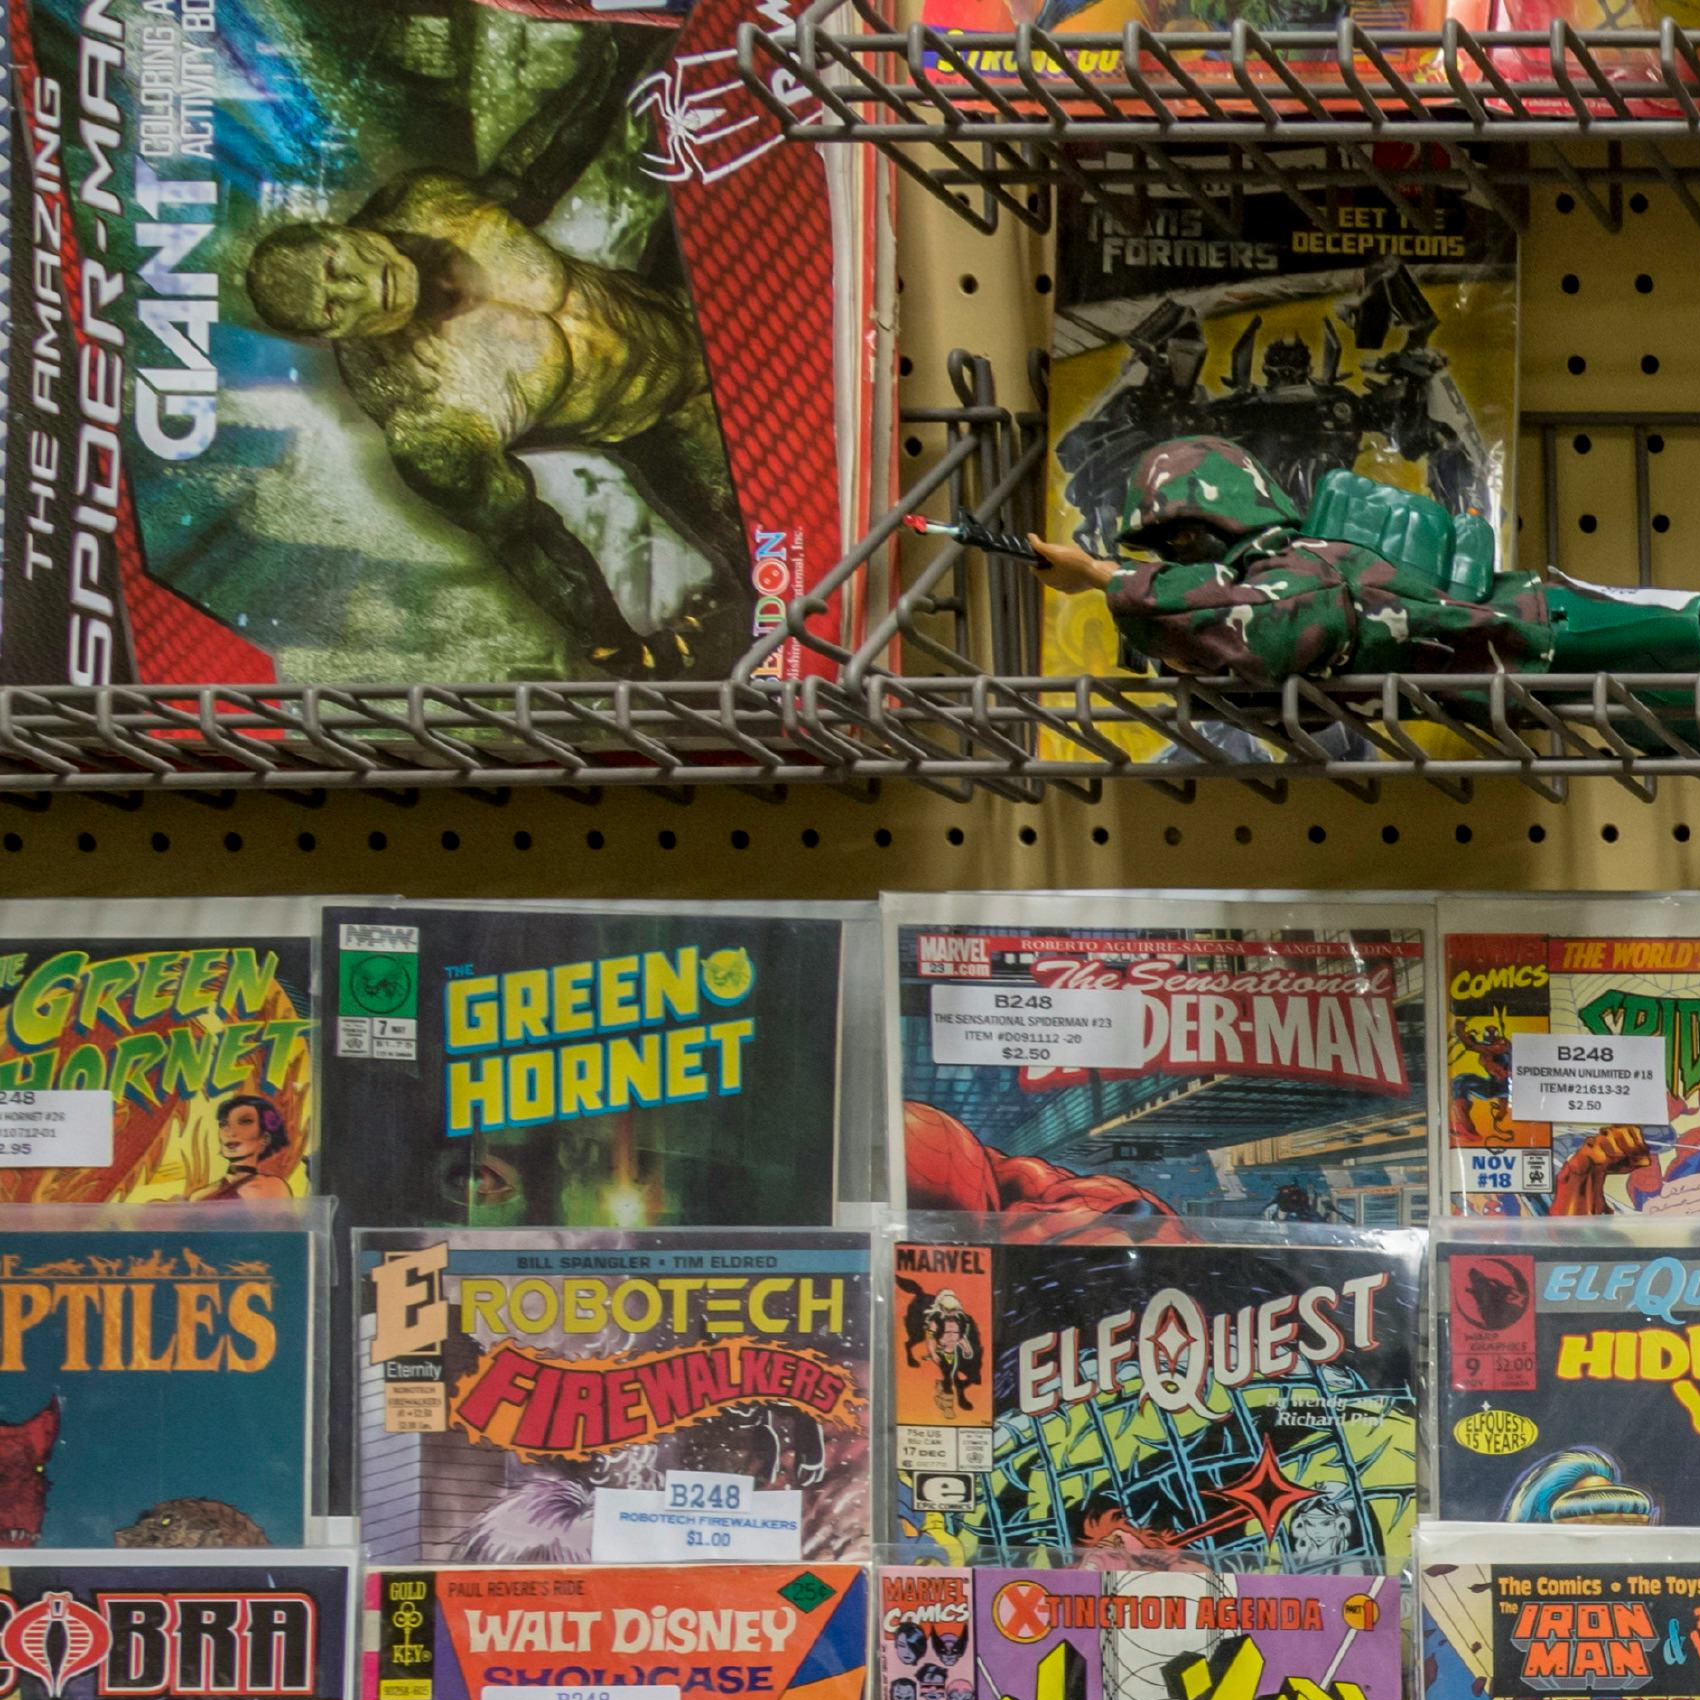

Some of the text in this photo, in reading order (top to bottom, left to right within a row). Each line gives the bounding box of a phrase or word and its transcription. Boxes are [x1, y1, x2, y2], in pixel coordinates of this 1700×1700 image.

[135, 158, 219, 462] GIANT
[25, 77, 62, 579] THE AMAZING
[446, 947, 703, 1048] GREEN
[995, 995, 1052, 1010] B248
[934, 1014, 1112, 1029] THE SENSATIONAL SPIDERMAN #23
[1002, 1048, 1050, 1061] $2.50
[1558, 1046, 1614, 1062] B248
[446, 1020, 754, 1136] HORNET
[1568, 1100, 1602, 1111] $2.50
[517, 1255, 650, 1270] BILL SPANGLER
[674, 1255, 777, 1269] TIM ELDRED
[461, 1280, 844, 1334] ROBOTECH
[456, 1346, 844, 1452] FIREWALKERS
[468, 1609, 600, 1652] WALT
